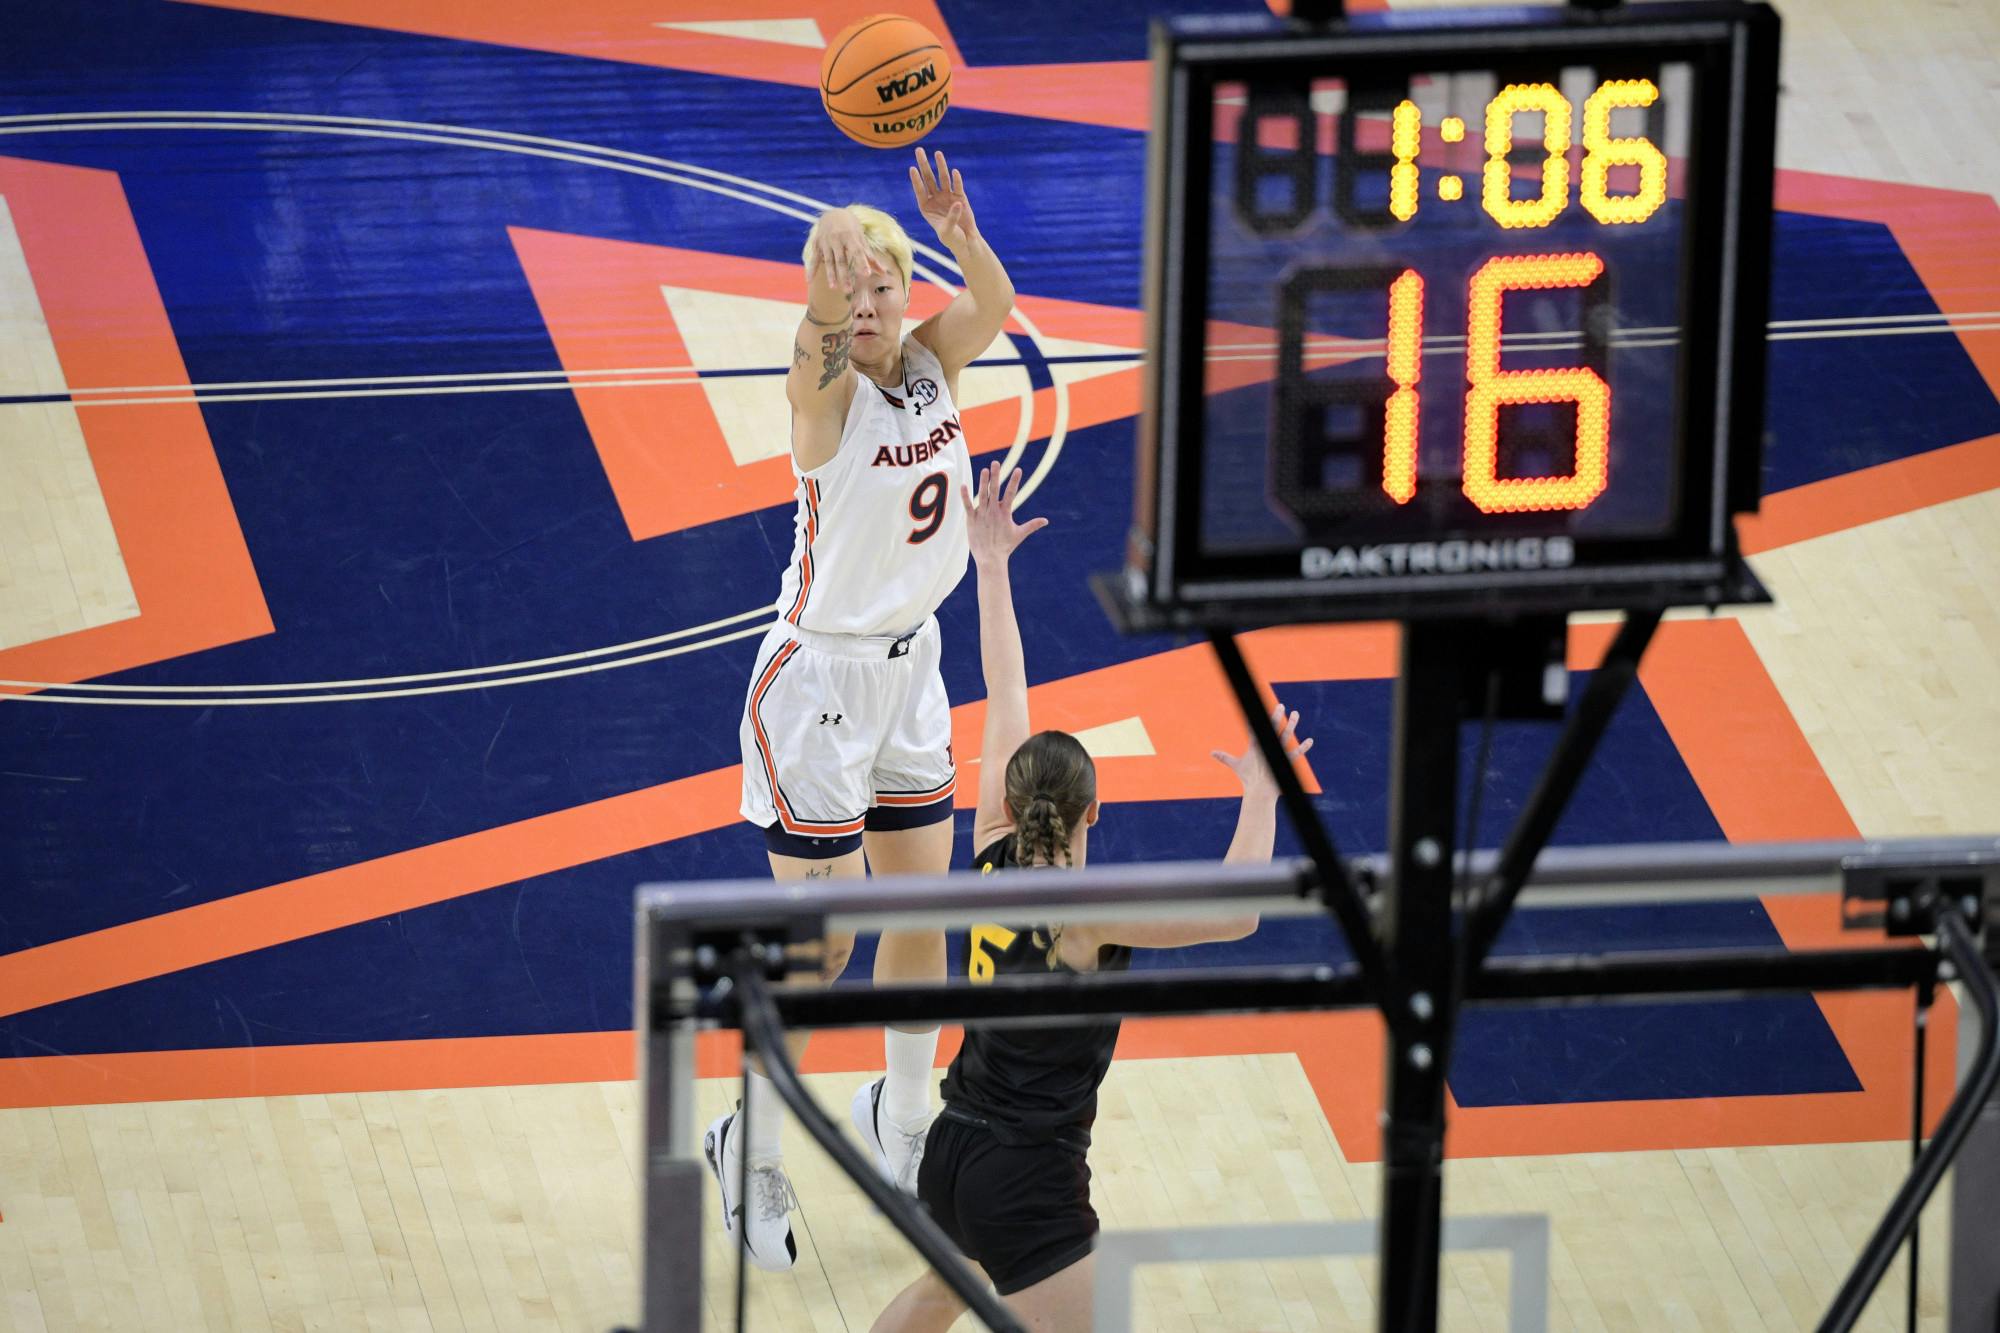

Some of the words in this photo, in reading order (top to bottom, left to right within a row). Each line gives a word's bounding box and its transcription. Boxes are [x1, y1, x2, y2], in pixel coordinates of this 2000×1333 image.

[873, 92, 949, 134] Wilson
[876, 64, 936, 103] NCAA
[1389, 78, 1667, 228] 1:06
[1382, 252, 1611, 514] 16
[907, 471, 949, 545] 9
[1300, 535, 1576, 579] DAKTRONICS
